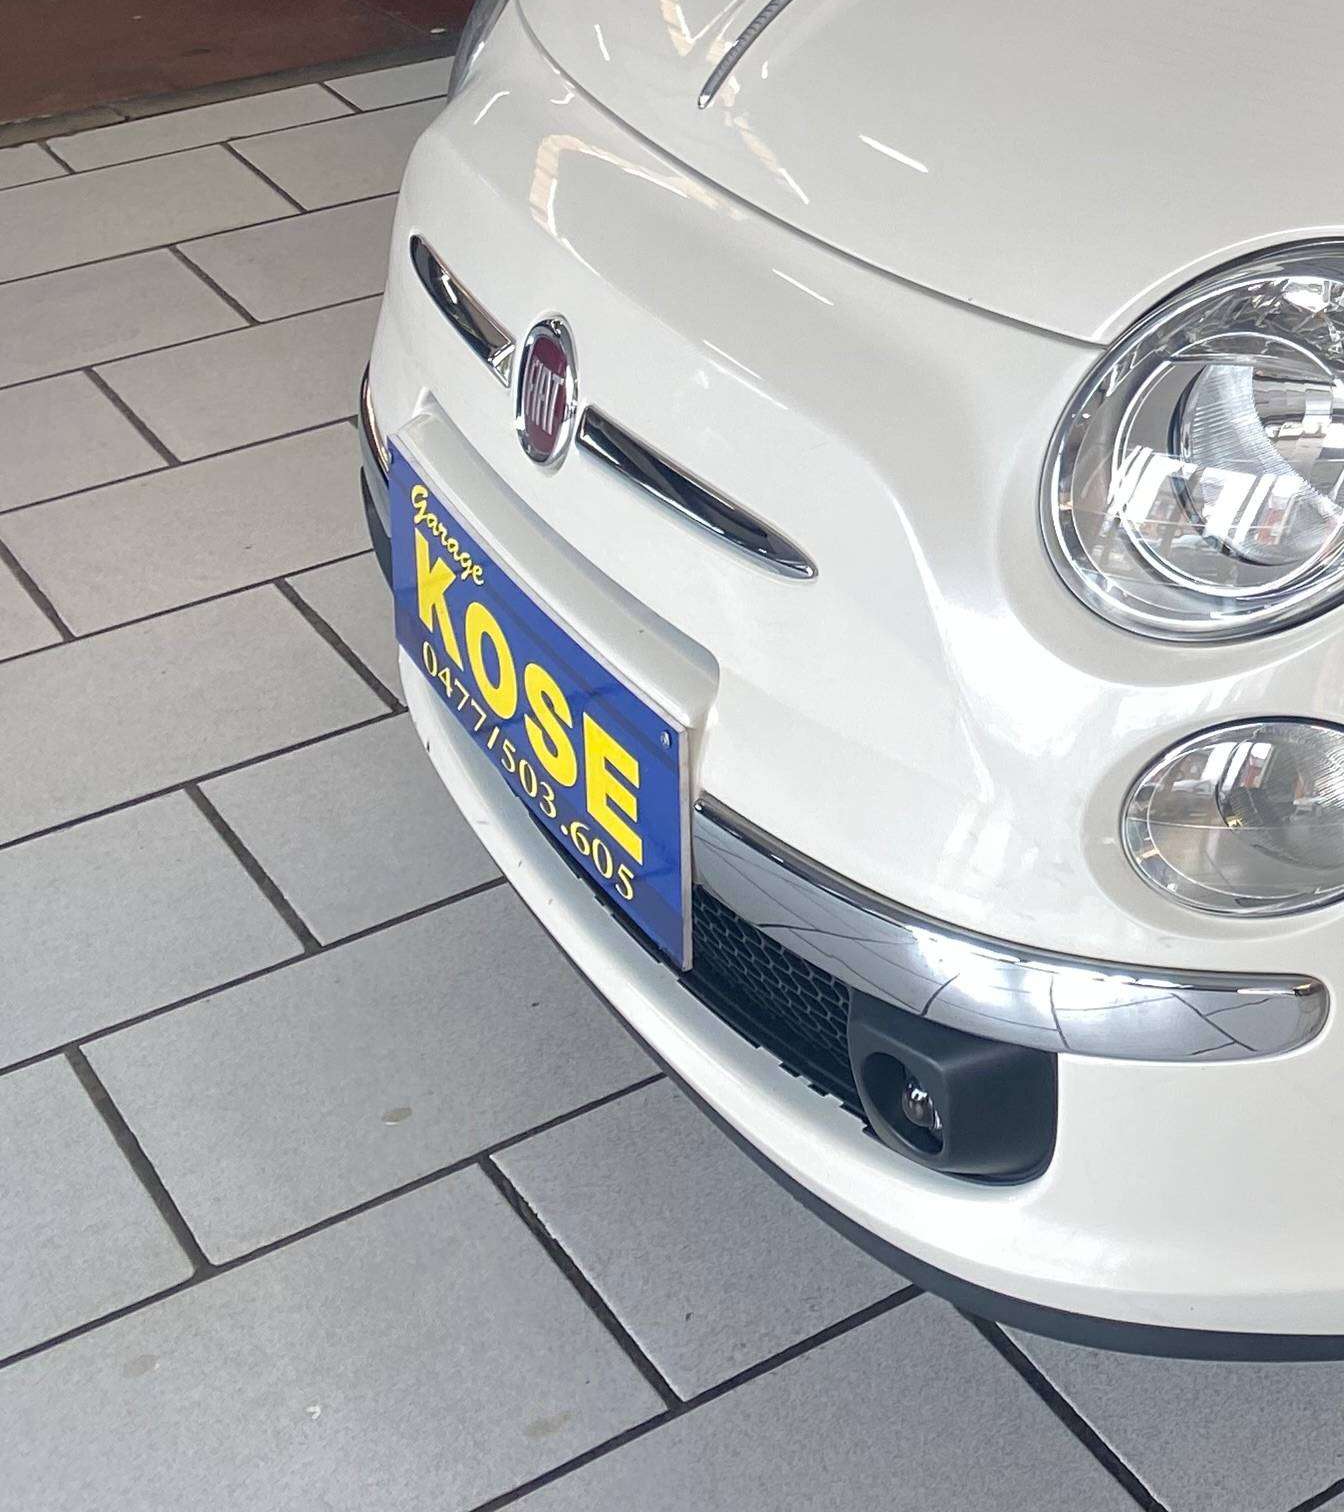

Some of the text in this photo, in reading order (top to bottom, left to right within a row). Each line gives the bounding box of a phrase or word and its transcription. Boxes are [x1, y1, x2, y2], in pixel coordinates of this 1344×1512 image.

[526, 359, 565, 435] FIAT
[411, 485, 484, 586] Garage
[415, 528, 643, 865] KOSE
[422, 641, 635, 902] 0477/503.605
